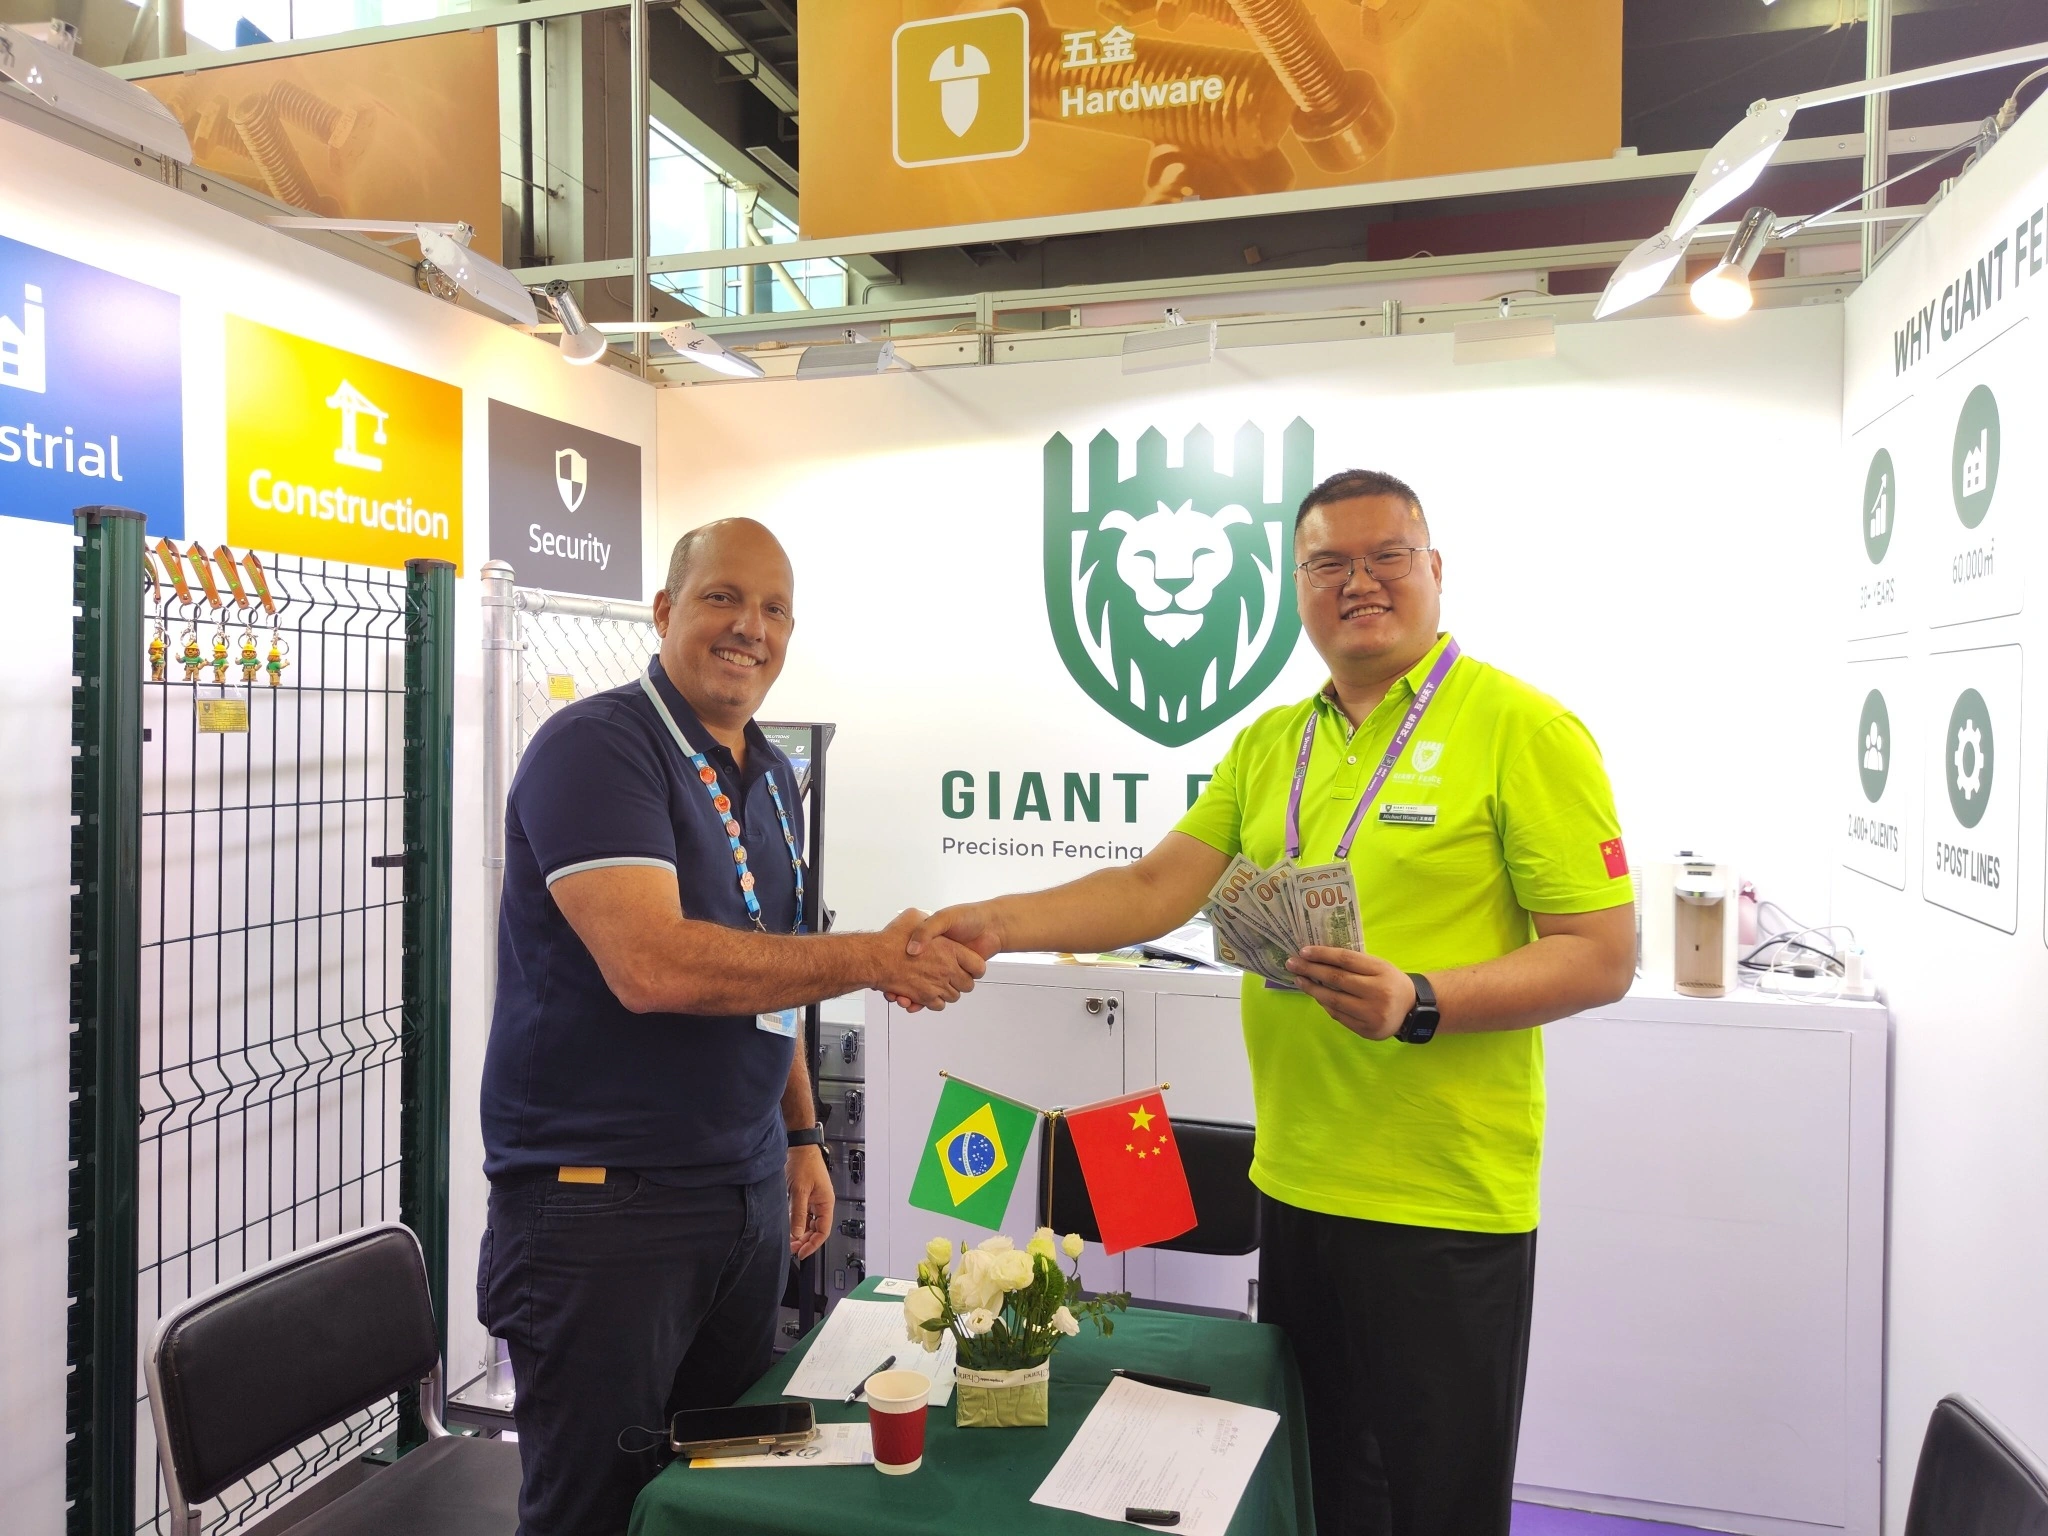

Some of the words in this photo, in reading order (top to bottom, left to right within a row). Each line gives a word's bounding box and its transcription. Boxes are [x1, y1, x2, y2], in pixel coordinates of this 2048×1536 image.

[1061, 26, 1136, 69] 五金
[1061, 76, 1224, 118] Hardware
[1893, 299, 1936, 377] WHY
[1941, 237, 2007, 342] GIANT
[2015, 202, 2048, 288] FE
[249, 468, 449, 540] Construction
[529, 523, 611, 571] Security
[1874, 577, 1895, 606] YEARS
[1396, 713, 1417, 745] 广交世界
[1414, 682, 1434, 711] 互利天下
[1301, 736, 1310, 756] Share
[941, 770, 1149, 823] GIANT
[942, 837, 1044, 858] Precision
[1052, 840, 1143, 863] Fencing
[1848, 813, 1868, 840] 2,400+
[1869, 820, 1899, 853] CLIENTS
[1221, 868, 1254, 903] 100
[1936, 841, 1942, 872] 5
[1943, 842, 1970, 879] POST
[1971, 849, 2000, 890] LINES
[1305, 885, 1347, 909] 100
